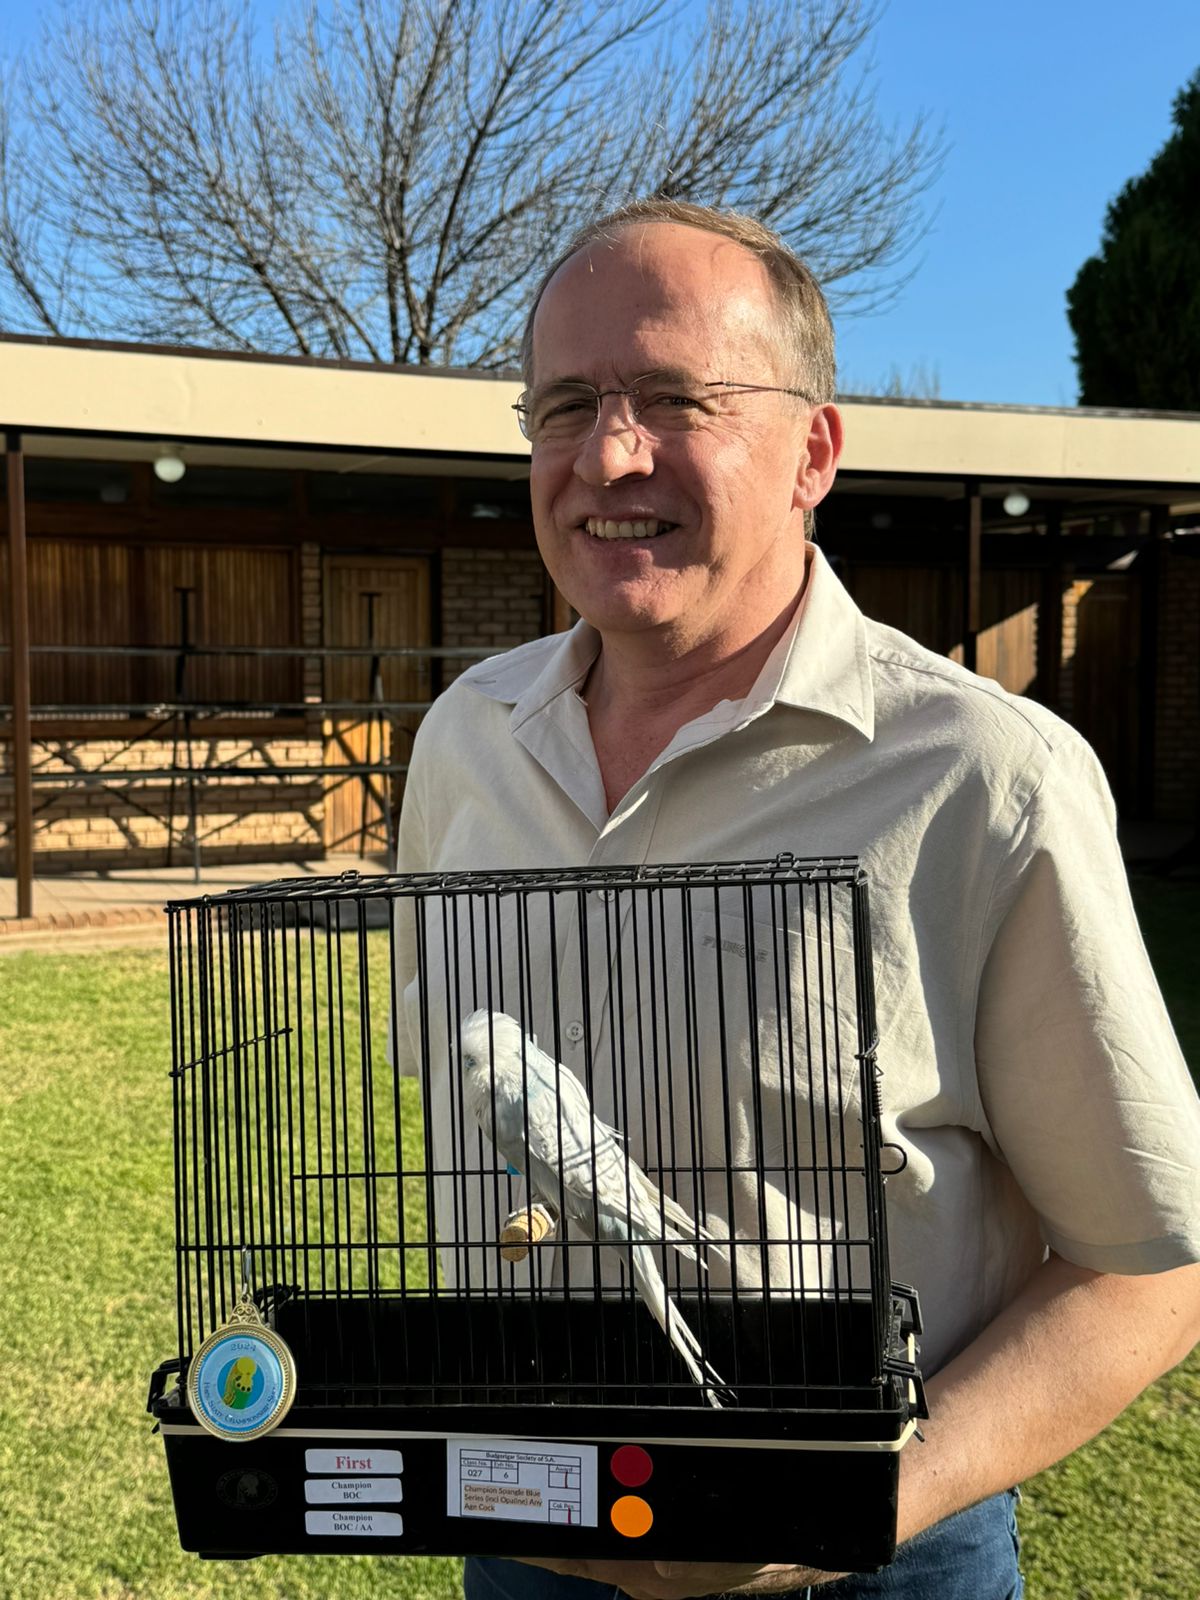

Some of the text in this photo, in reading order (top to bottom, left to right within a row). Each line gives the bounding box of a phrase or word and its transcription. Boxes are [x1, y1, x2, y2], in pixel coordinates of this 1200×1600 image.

[516, 1454, 537, 1462] Society
[335, 1456, 372, 1470] First
[467, 1469, 483, 1477] 027
[331, 1481, 372, 1490] Champion
[464, 1484, 541, 1496] Champion Spangle Blue
[343, 1491, 363, 1500] BOC
[464, 1493, 484, 1501] Series
[529, 1498, 543, 1507] Any
[464, 1503, 496, 1512] Age Cock
[332, 1513, 373, 1522] Champion
[334, 1523, 354, 1531] BOC
